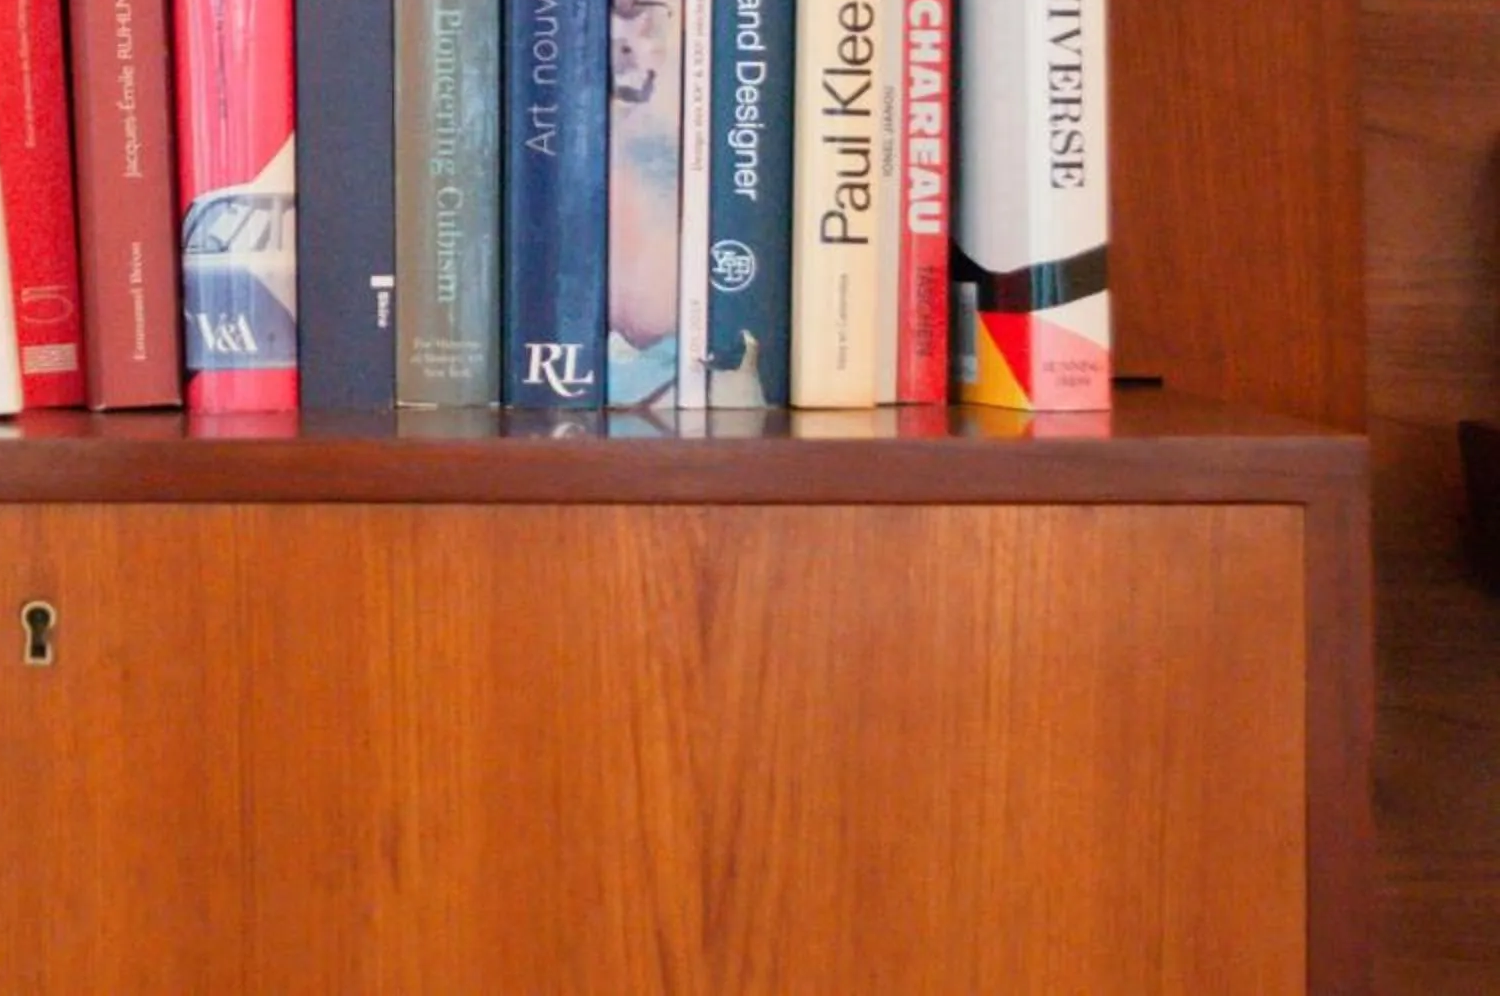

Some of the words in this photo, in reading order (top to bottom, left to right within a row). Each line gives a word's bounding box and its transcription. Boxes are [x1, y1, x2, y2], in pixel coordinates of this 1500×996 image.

[432, 8, 463, 175] Pioneering
[822, 0, 874, 117] Klee
[525, 102, 557, 156] Art
[728, 61, 766, 201] Designer
[436, 186, 464, 304] Cubism
[820, 135, 873, 245] Paul
[197, 312, 258, 353] V&A
[915, 264, 936, 358] TASCHEN
[522, 342, 596, 398] RL
